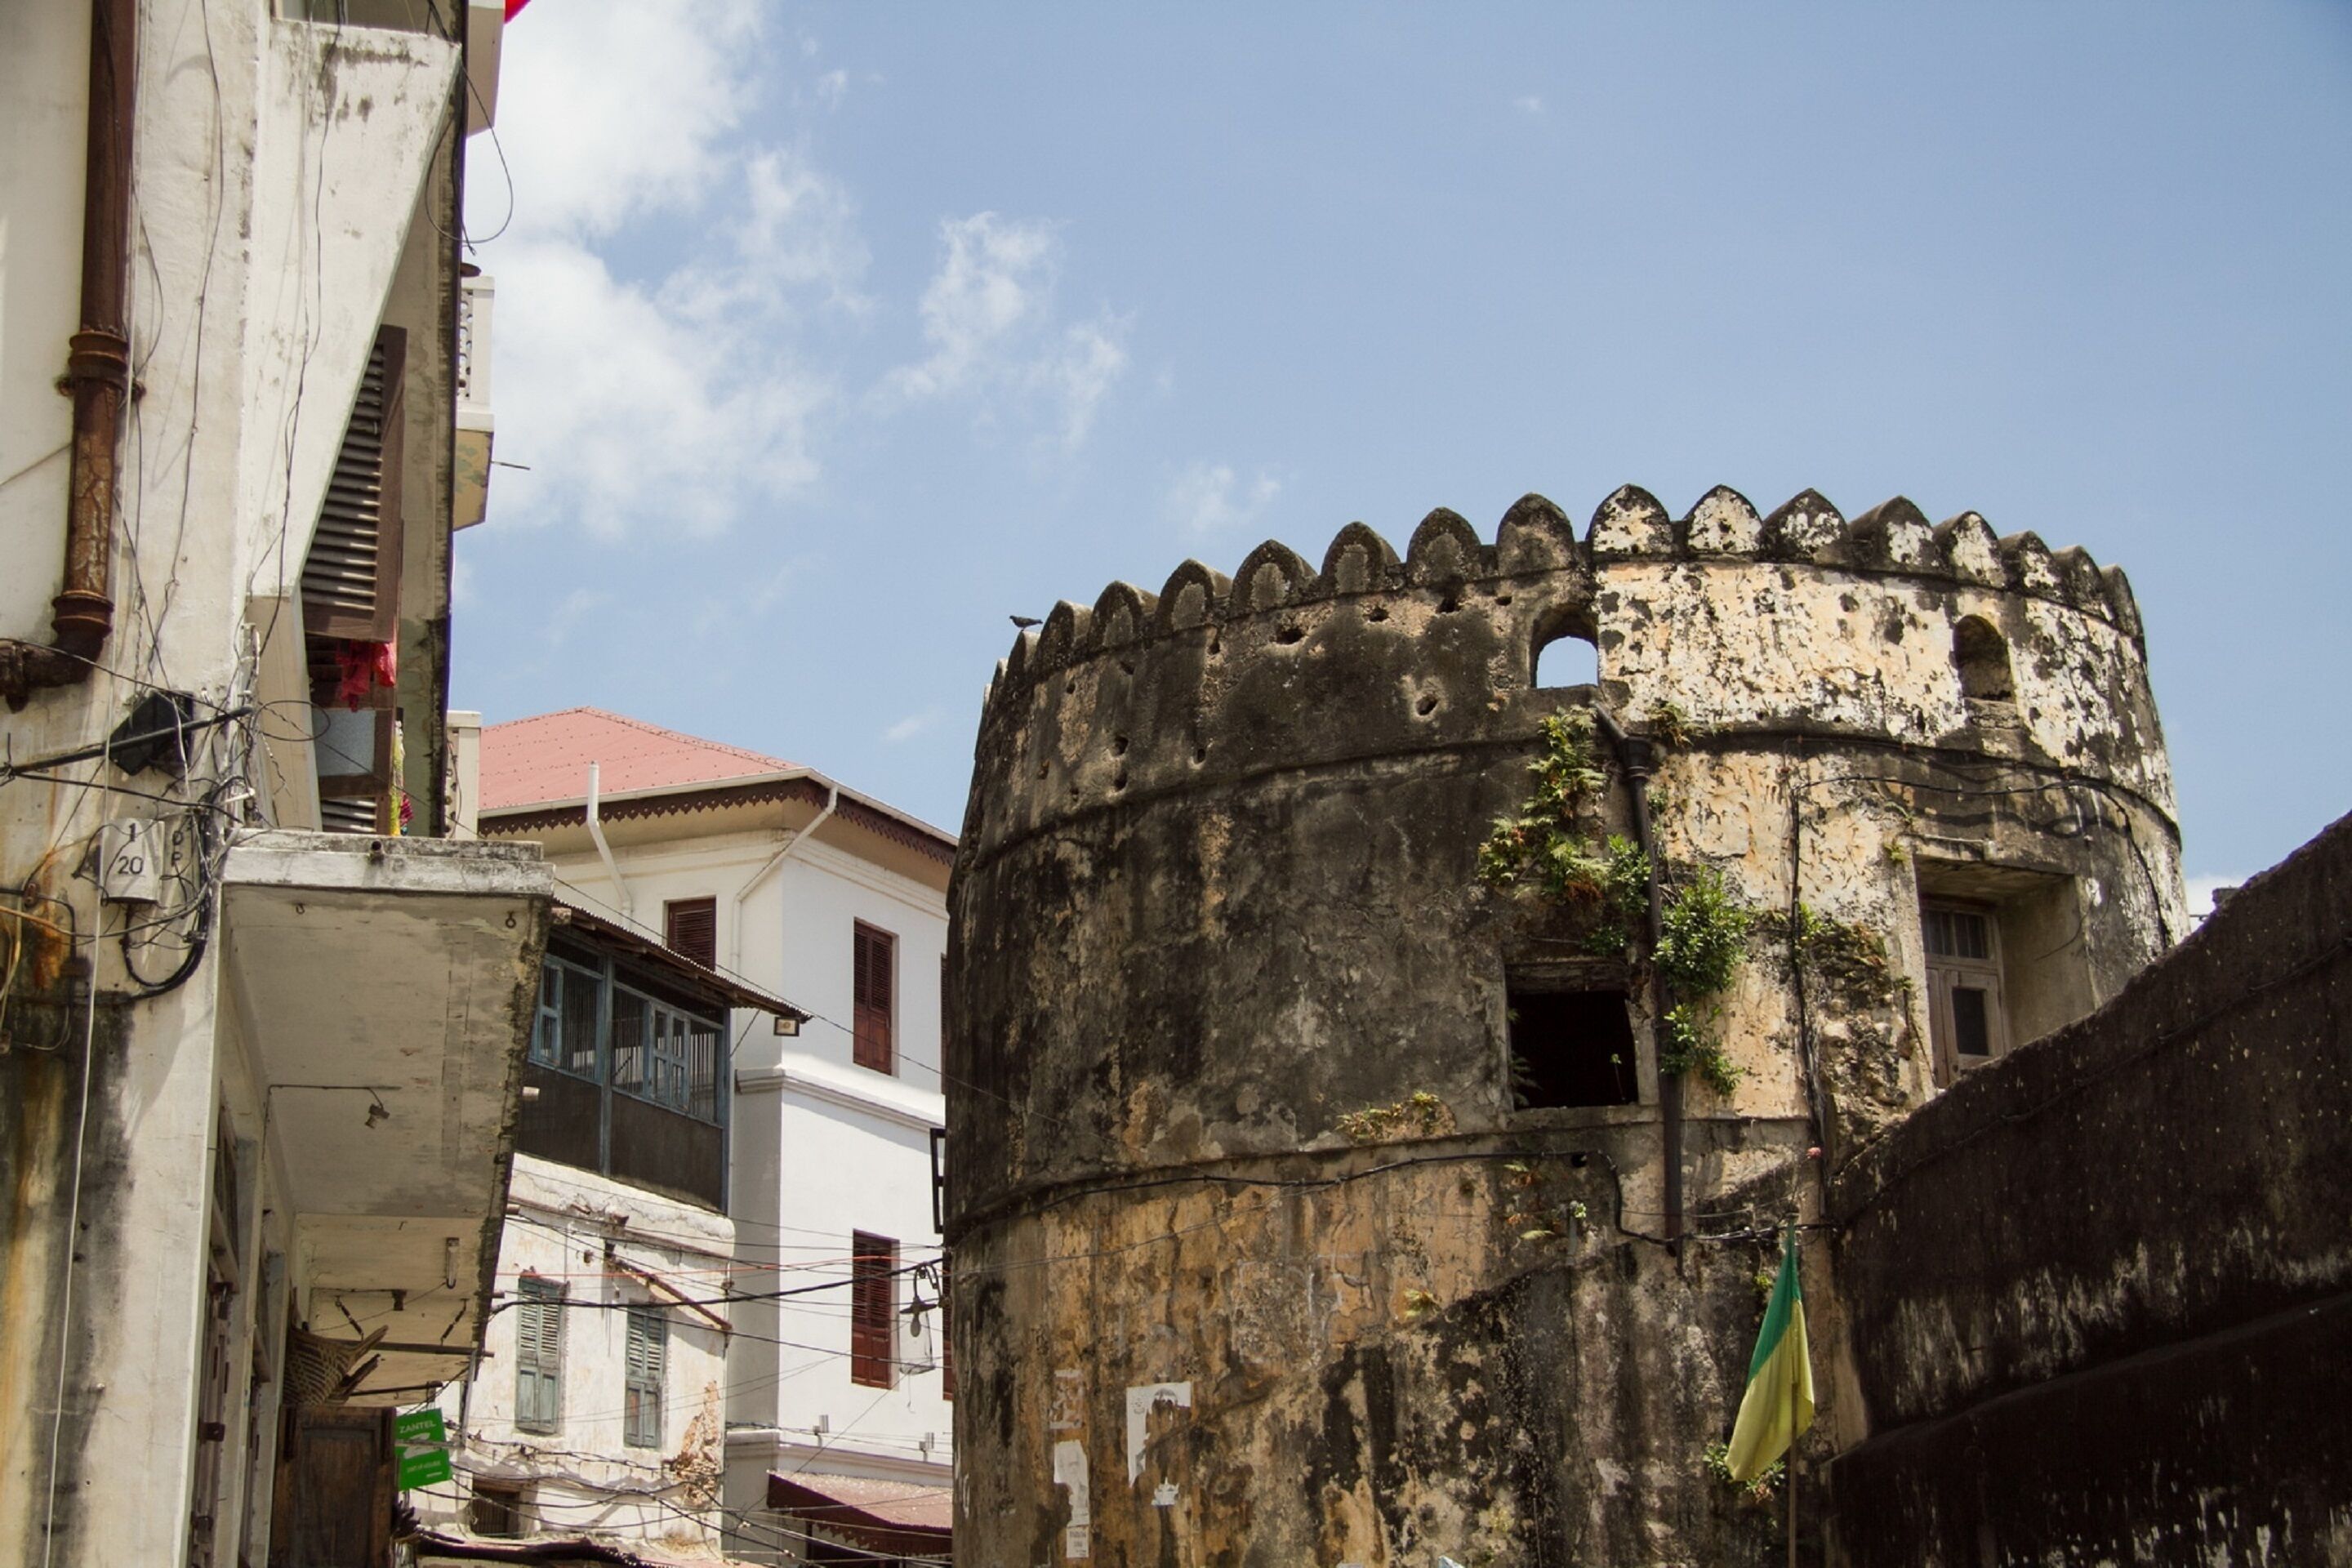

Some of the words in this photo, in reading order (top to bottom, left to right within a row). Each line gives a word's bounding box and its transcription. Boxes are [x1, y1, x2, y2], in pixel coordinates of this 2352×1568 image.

[128, 823, 136, 843] 1
[118, 855, 144, 875] 20
[399, 1420, 437, 1434] ZANTEL
